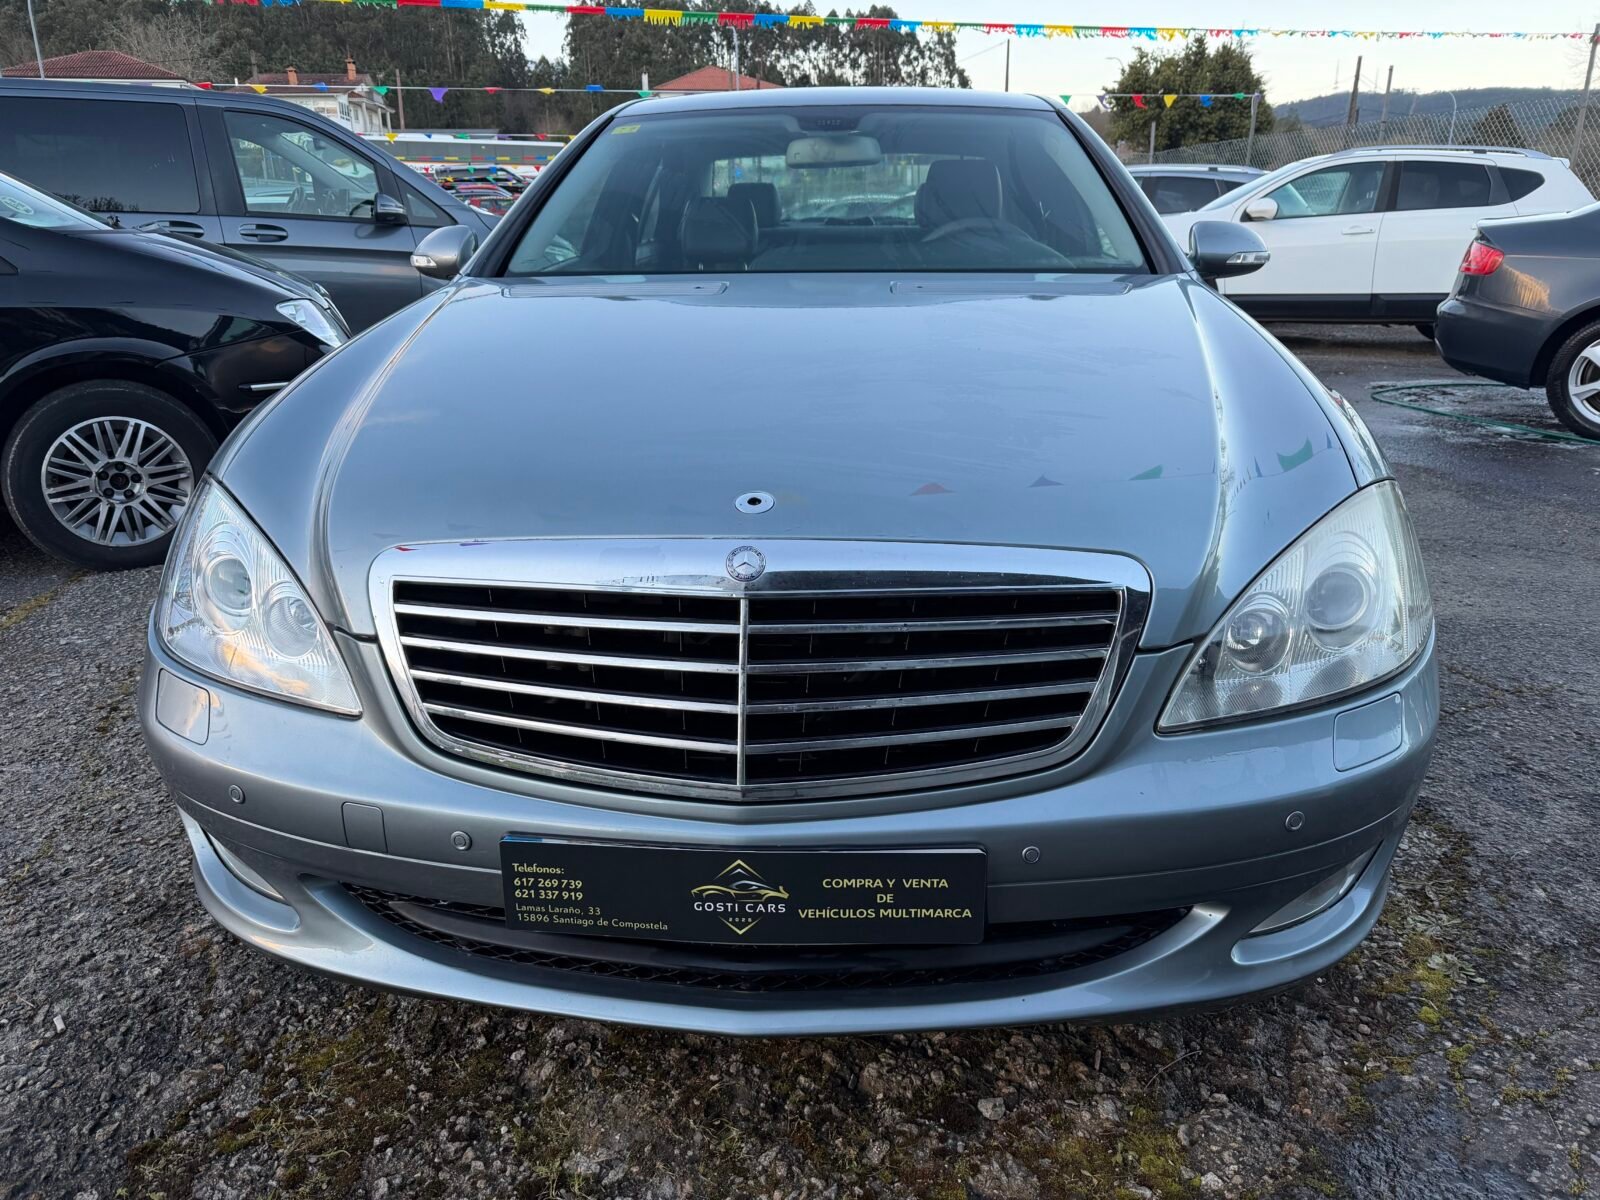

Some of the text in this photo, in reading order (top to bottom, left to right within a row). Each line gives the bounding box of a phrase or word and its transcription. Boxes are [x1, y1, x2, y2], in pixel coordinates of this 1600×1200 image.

[513, 863, 564, 875] Telefonos:
[514, 877, 583, 889] 617 269 739
[822, 878, 949, 889] COMPRA Y VENTA
[514, 889, 583, 901] 621 337 919
[876, 893, 894, 903] DE
[516, 903, 601, 916] Lamas Laraño, 33
[694, 902, 786, 913] GOSTI CARS
[798, 906, 972, 919] VEHÍCULOS MULTIMARCA
[517, 913, 668, 931] 15896 Santiago de Compostela
